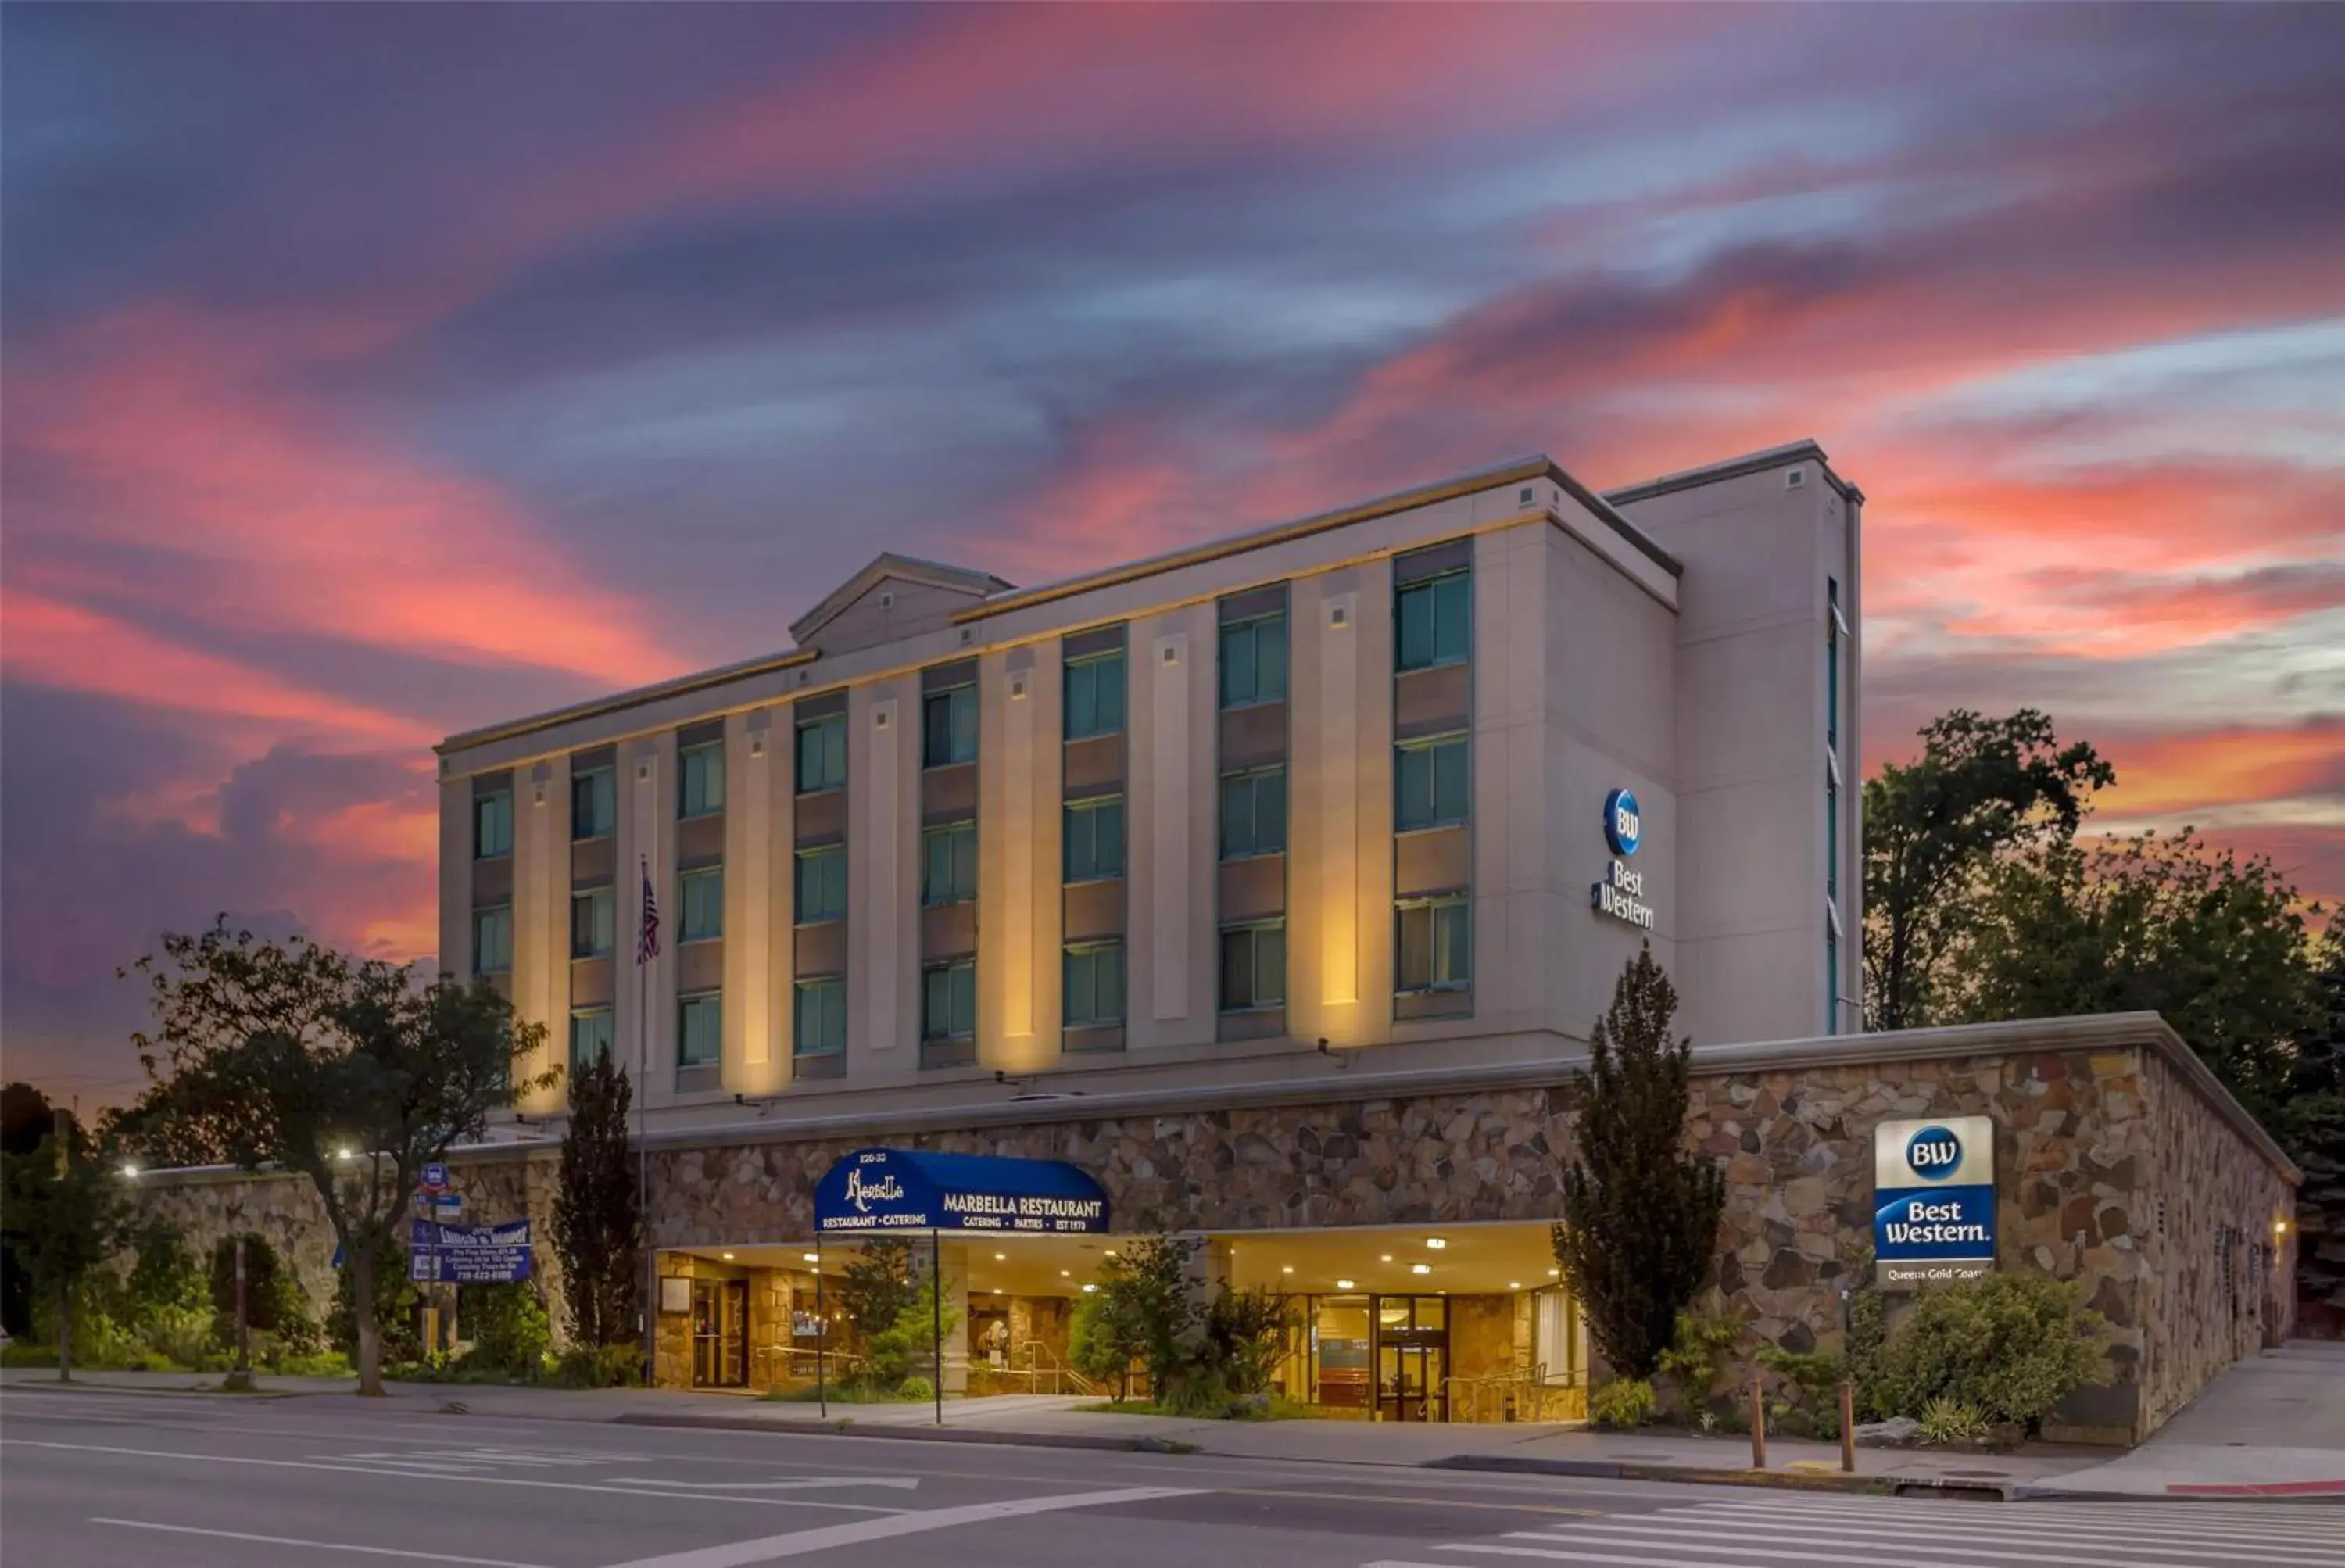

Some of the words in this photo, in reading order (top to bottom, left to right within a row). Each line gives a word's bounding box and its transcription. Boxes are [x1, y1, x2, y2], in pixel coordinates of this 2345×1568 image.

[1617, 807, 1639, 840] BW
[1614, 860, 1643, 897] Best
[1600, 882, 1654, 930] Western
[1913, 1141, 1957, 1165] BW
[943, 1193, 1016, 1214] MARBELLA
[1020, 1197, 1102, 1218] RESTAURANT
[1908, 1201, 1962, 1222] Best
[823, 1215, 877, 1228] RESTAURANT
[883, 1214, 926, 1225] CATERING
[962, 1216, 1001, 1228] CATERING
[1888, 1269, 1926, 1281] Queens
[1928, 1269, 1953, 1280] Gold
